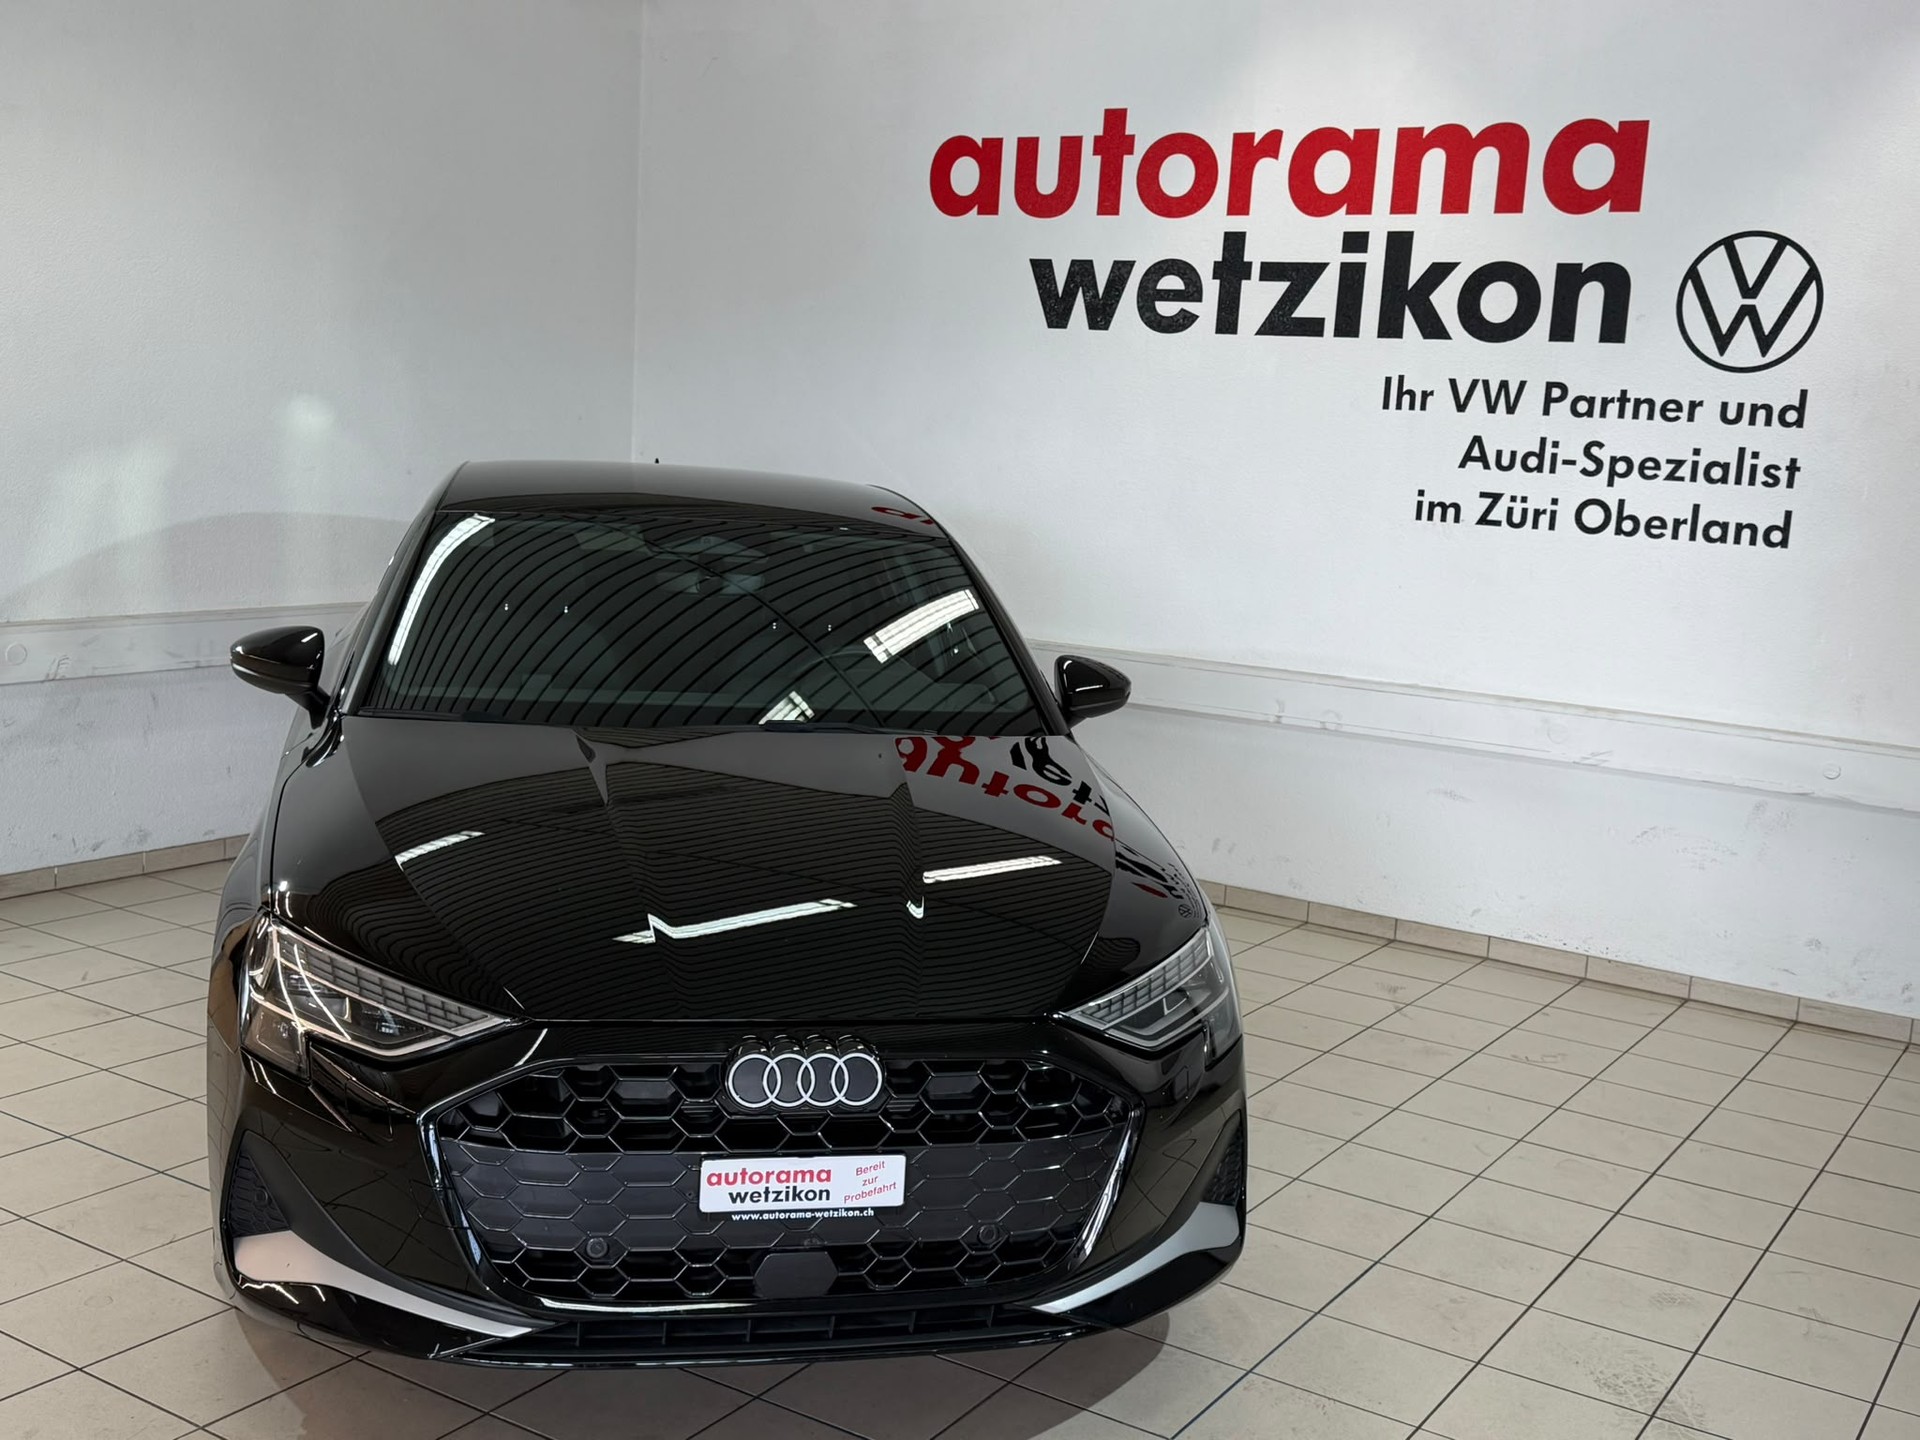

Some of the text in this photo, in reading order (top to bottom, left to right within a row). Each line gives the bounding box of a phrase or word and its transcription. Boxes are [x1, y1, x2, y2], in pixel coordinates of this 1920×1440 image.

[930, 108, 1650, 219] autorama
[1030, 231, 1632, 343] wetzikon
[1677, 232, 1823, 372] VW
[1382, 375, 1809, 429] Ihr VW Partner und
[1458, 435, 1801, 489] Audi-Spezialist
[1415, 489, 1793, 549] im Züri Oberland
[707, 1168, 832, 1186] autorama
[855, 1160, 885, 1176] Bereit
[862, 1175, 879, 1186] zur
[728, 1185, 830, 1204] wetzikon
[843, 1181, 897, 1204] Probefahrt
[731, 1207, 874, 1221] www.autorama-wetzikon.ch
